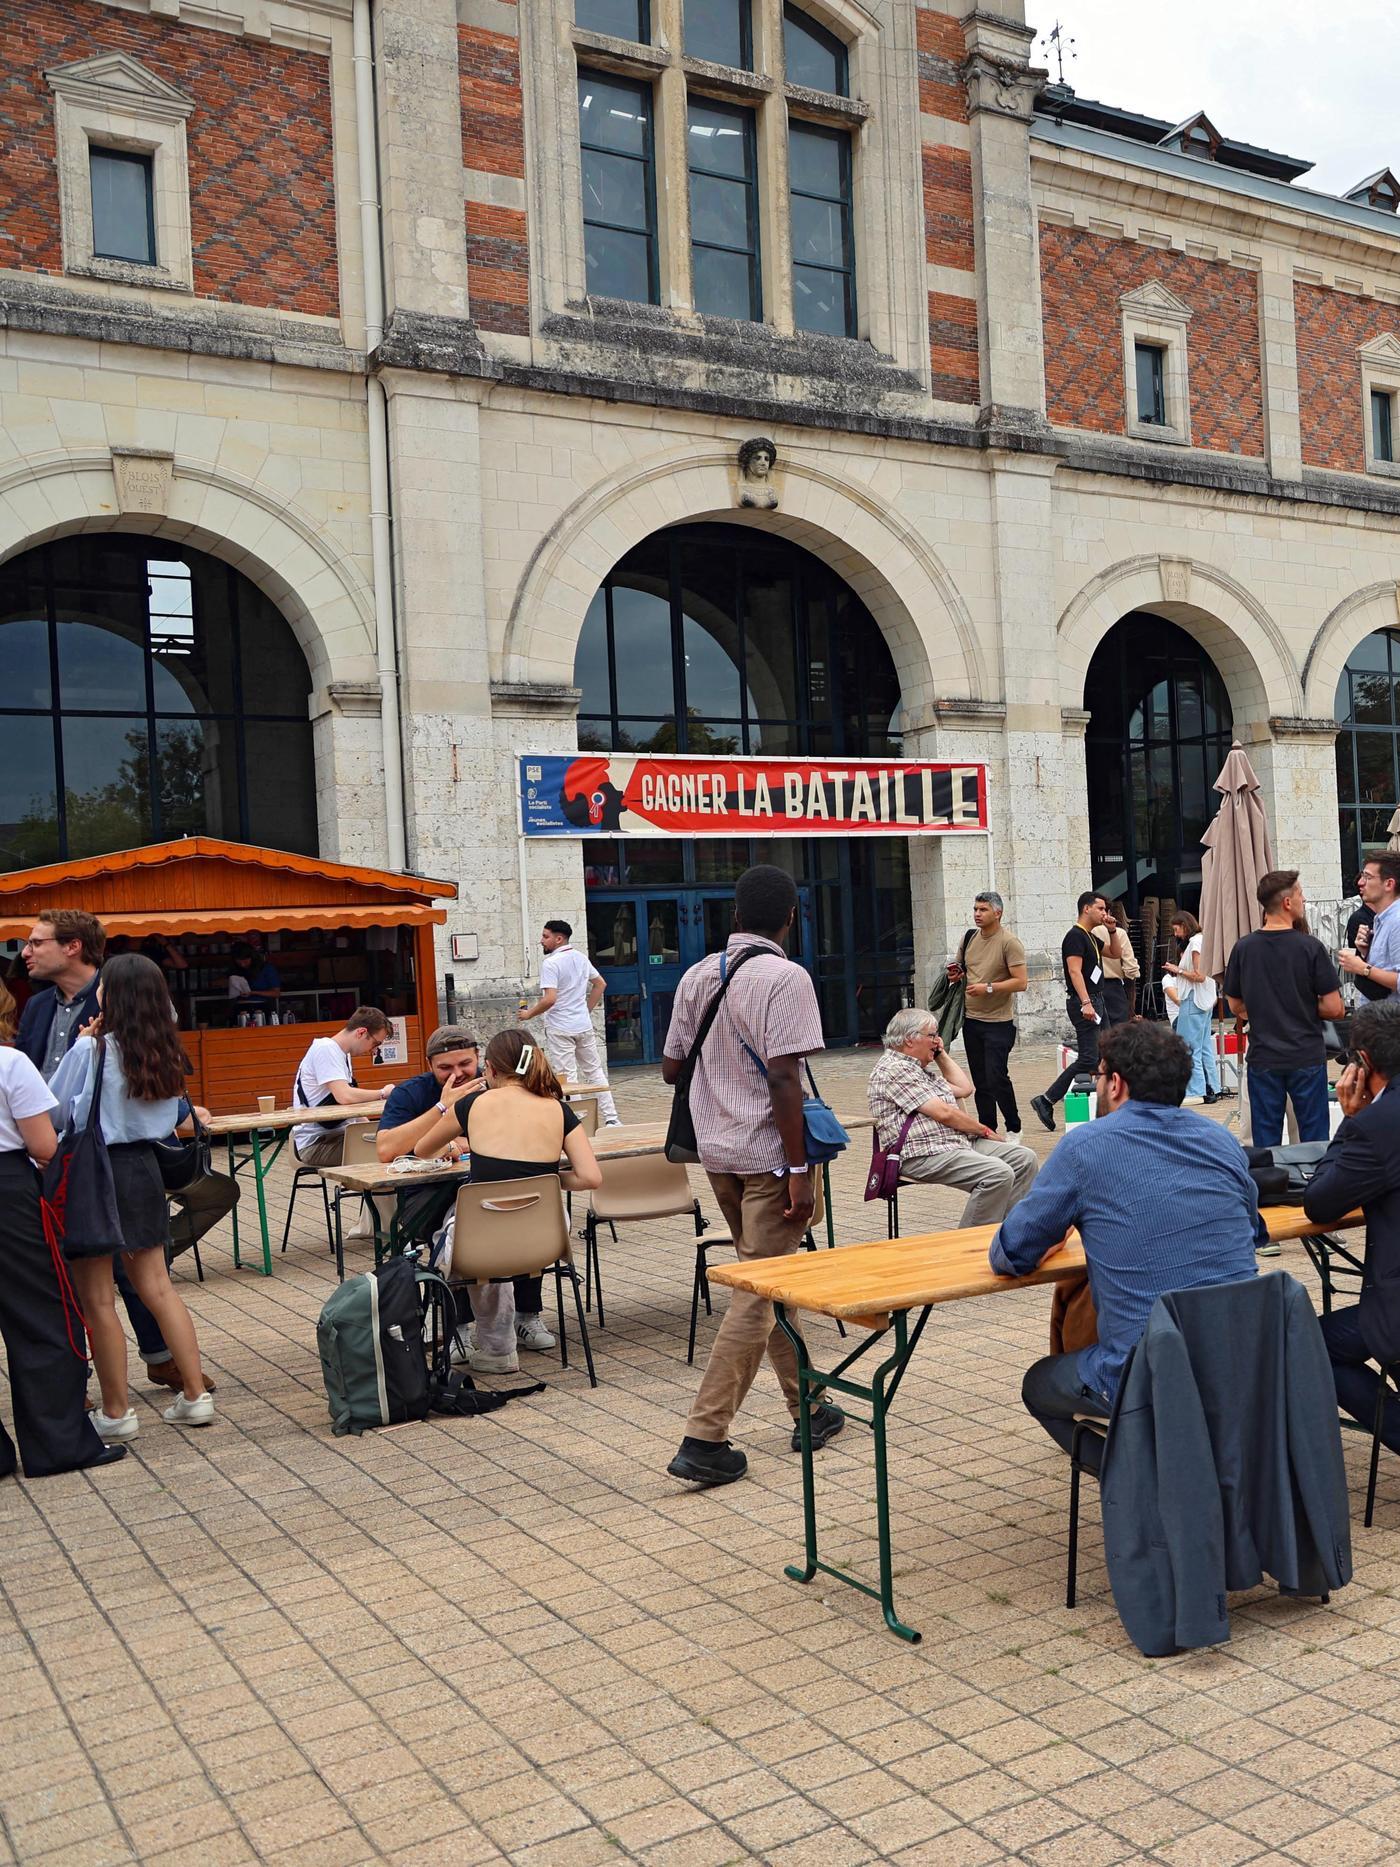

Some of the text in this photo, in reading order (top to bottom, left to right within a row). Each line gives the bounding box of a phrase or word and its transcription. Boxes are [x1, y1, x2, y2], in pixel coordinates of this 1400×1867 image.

[128, 471, 159, 482] BLOIS
[128, 484, 159, 495] OUEST
[642, 767, 980, 826] GAGNER LA BATAILLE
